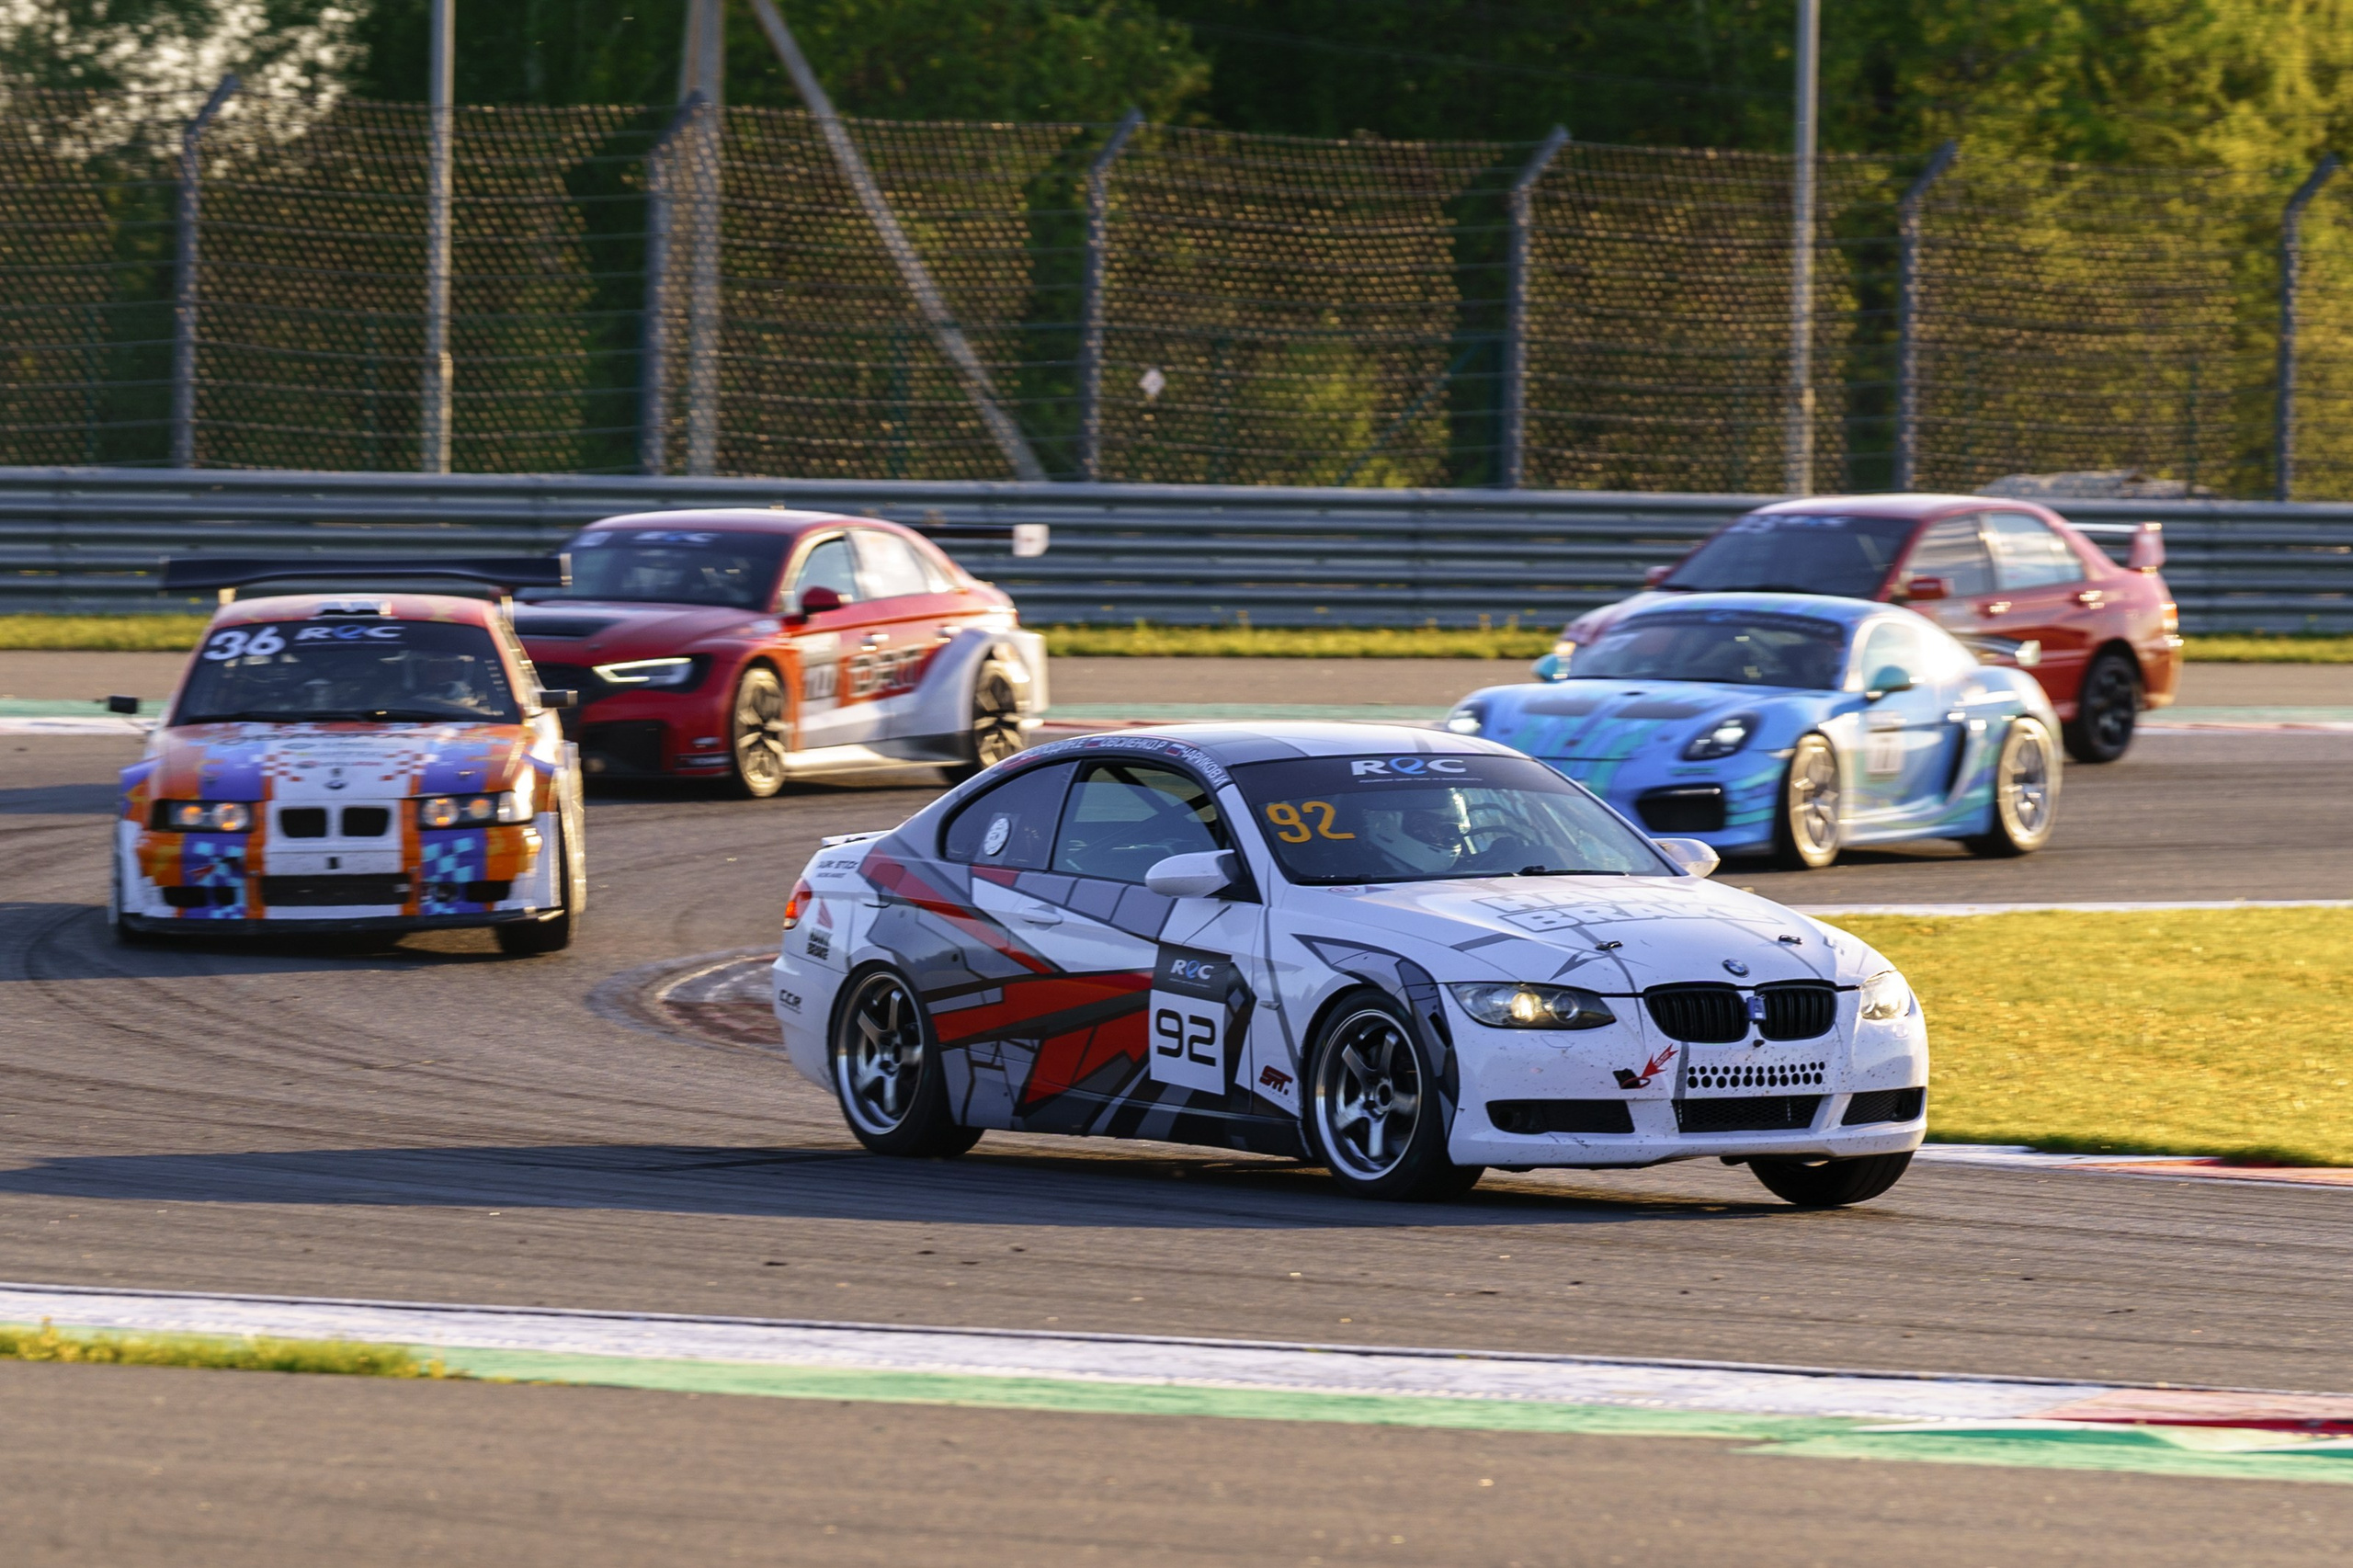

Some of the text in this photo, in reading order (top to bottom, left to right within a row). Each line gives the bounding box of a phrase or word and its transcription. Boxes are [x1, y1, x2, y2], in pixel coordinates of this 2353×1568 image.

[203, 626, 287, 661] 36
[1266, 801, 1356, 844] 92
[1497, 903, 1787, 933] BRAKE
[1155, 1007, 1217, 1067] 92
